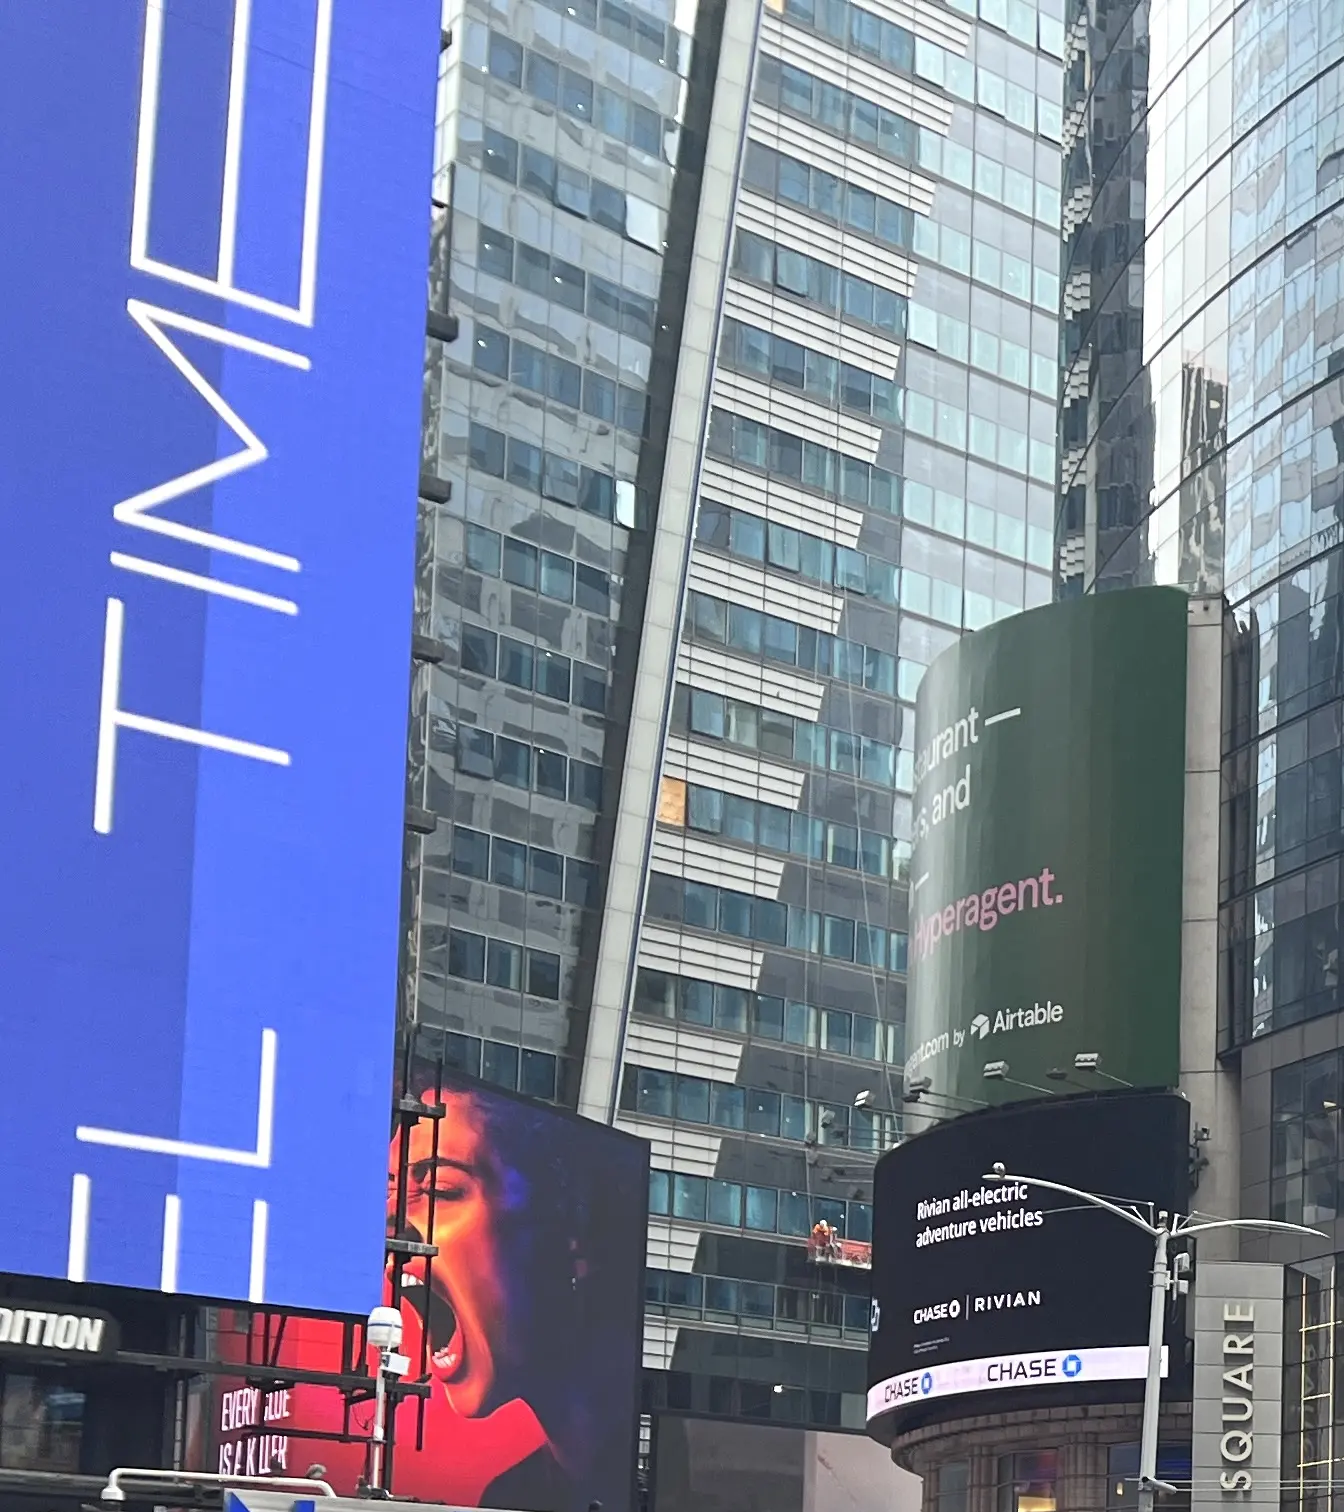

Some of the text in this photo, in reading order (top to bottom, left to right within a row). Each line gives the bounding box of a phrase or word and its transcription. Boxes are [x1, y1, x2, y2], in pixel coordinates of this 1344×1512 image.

[932, 764, 971, 826] and
[914, 868, 1064, 961] Hyperagent.
[953, 1028, 966, 1047] by
[992, 1000, 1064, 1034] Airtable
[917, 1181, 1028, 1221] Rivian all-electric
[916, 1208, 1044, 1248] adventure vehicles
[913, 1290, 1041, 1325] CHASE RIVIAN
[884, 1377, 919, 1403] CHASE
[987, 1358, 1057, 1382] CHASE
[221, 1387, 259, 1432] EVERY
[1220, 1303, 1255, 1492] SQUARE
[246, 1435, 288, 1476] KLLER
